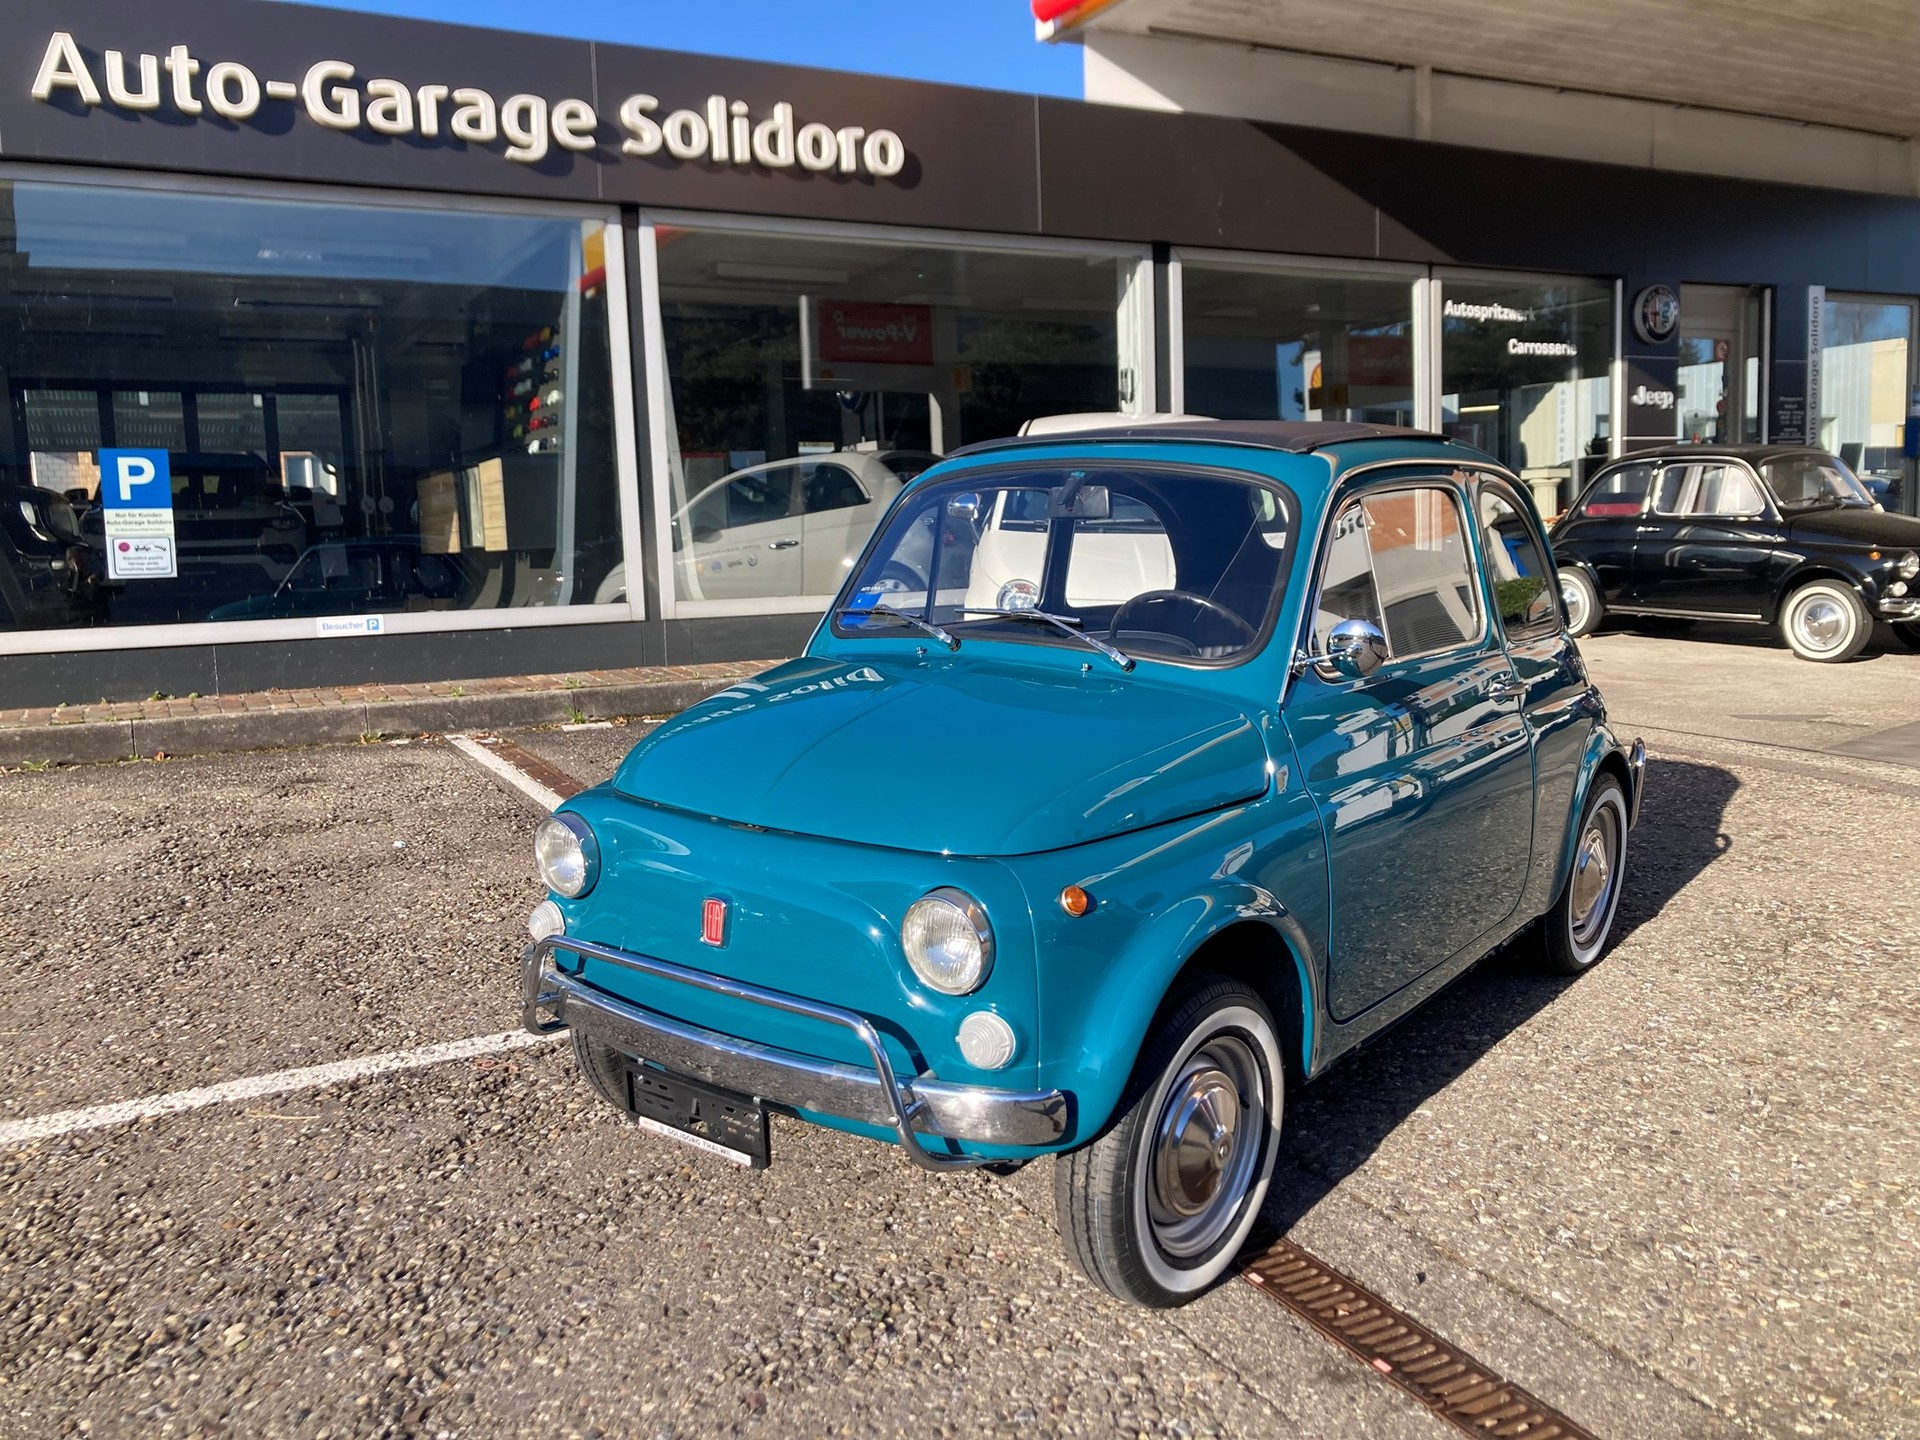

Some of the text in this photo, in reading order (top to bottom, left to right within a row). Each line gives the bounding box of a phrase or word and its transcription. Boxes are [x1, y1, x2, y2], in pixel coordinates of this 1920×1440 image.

[30, 31, 906, 178] Auto-Garage Solidoro
[1811, 296, 1820, 355] Solidoro
[1630, 385, 1674, 409] Jeep
[117, 456, 156, 501] P
[322, 621, 363, 631] Besucher
